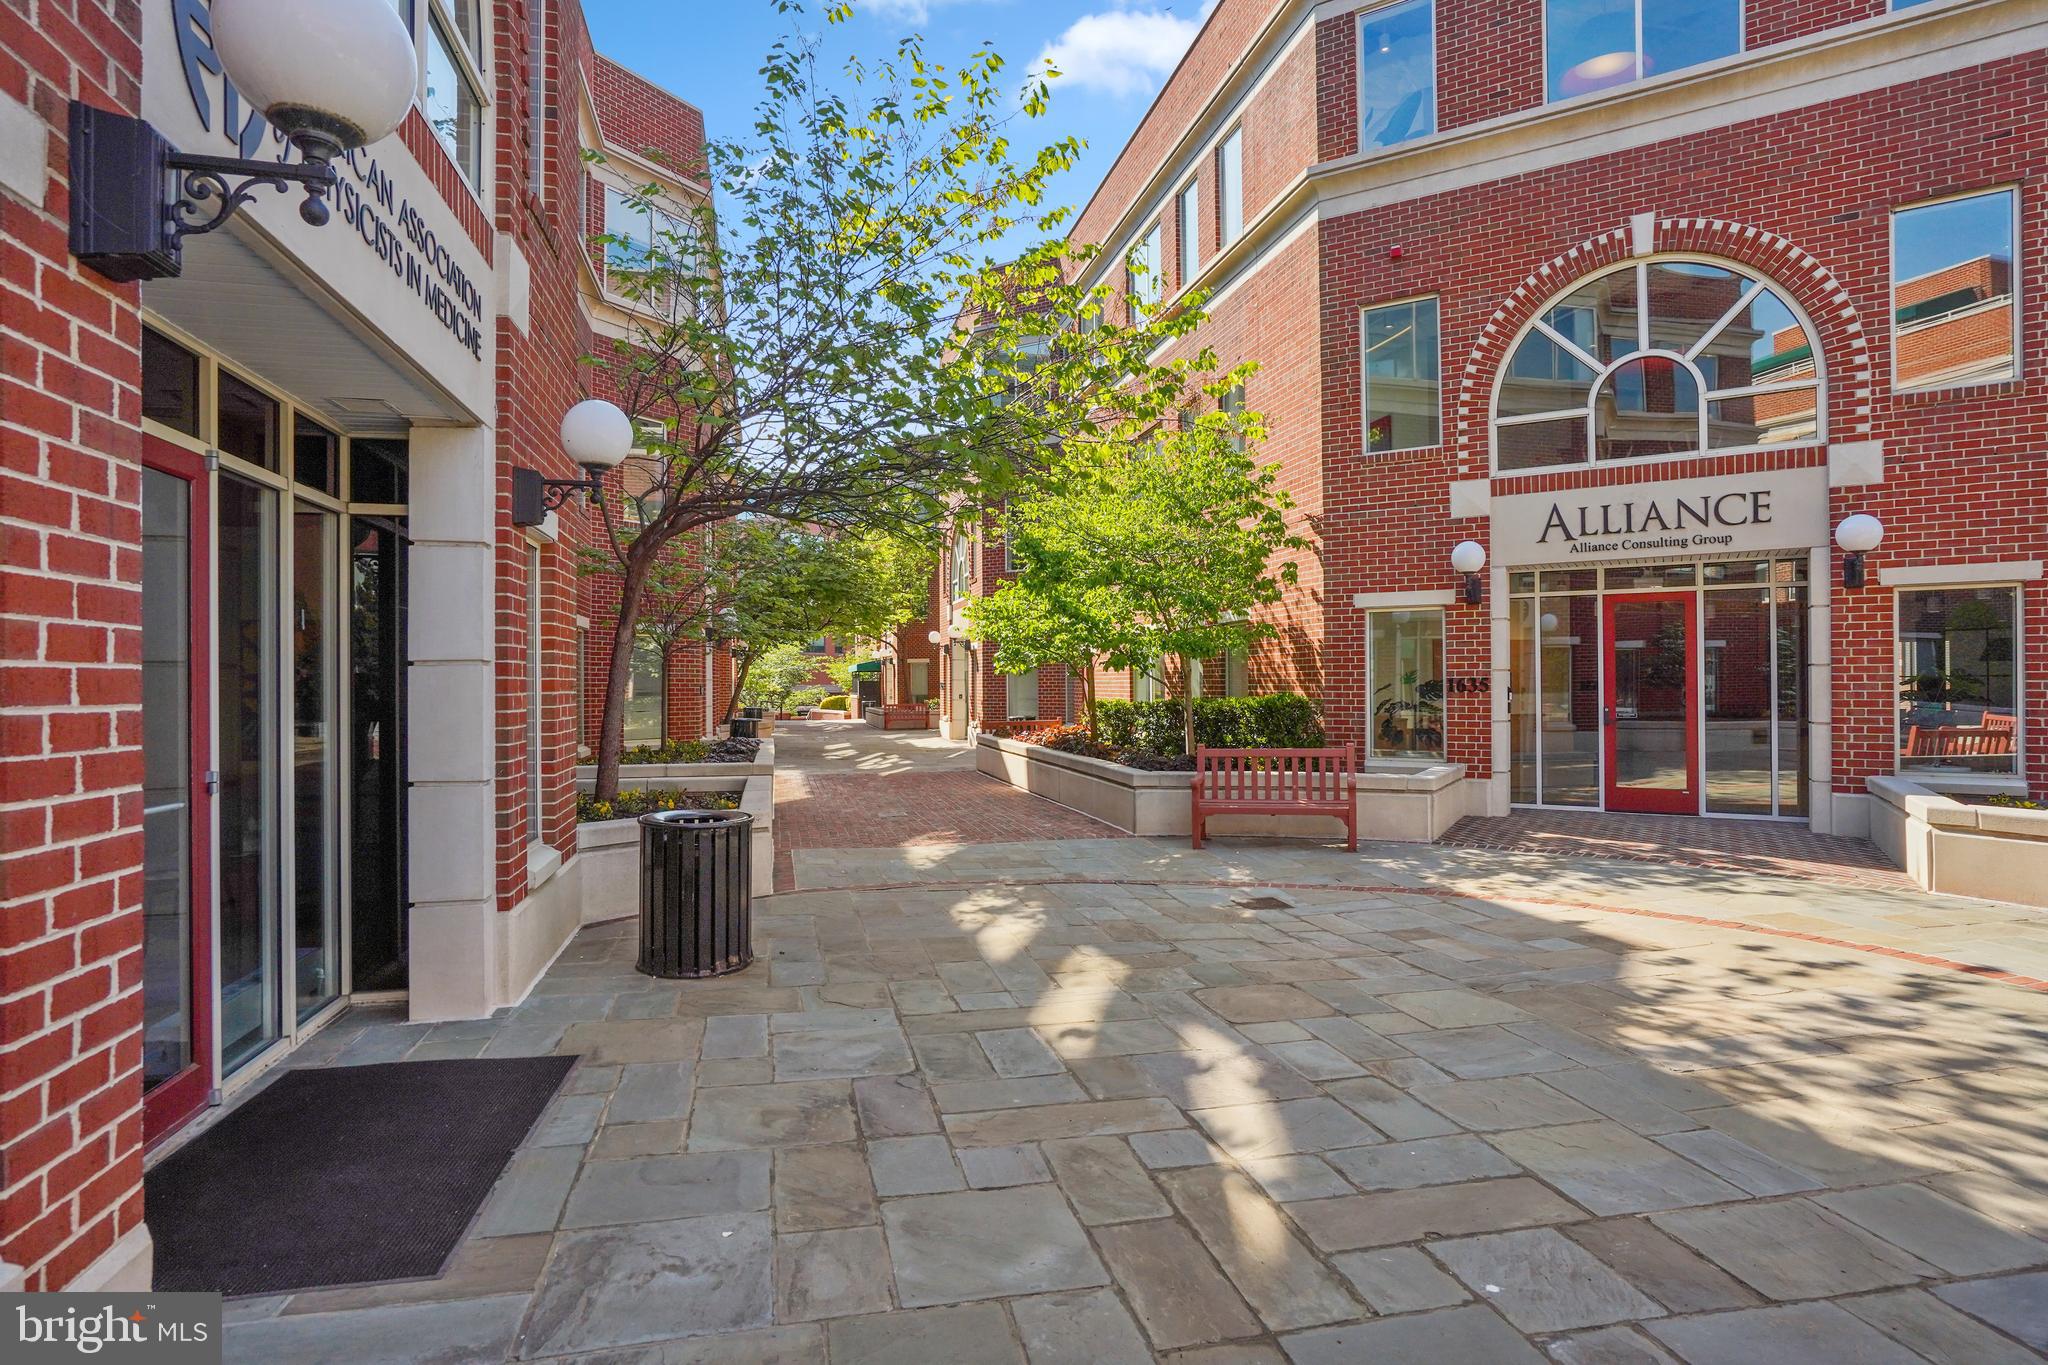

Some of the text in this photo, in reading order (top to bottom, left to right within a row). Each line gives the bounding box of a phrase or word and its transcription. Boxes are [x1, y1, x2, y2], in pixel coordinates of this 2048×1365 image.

[326, 165, 403, 278] YSICISTS
[406, 252, 422, 297] IN
[425, 274, 482, 363] MEDICINE
[398, 199, 482, 323] ASSOCIATION
[1569, 533, 1733, 554] Alliance Consulting Group
[1447, 676, 1489, 693] 1635
